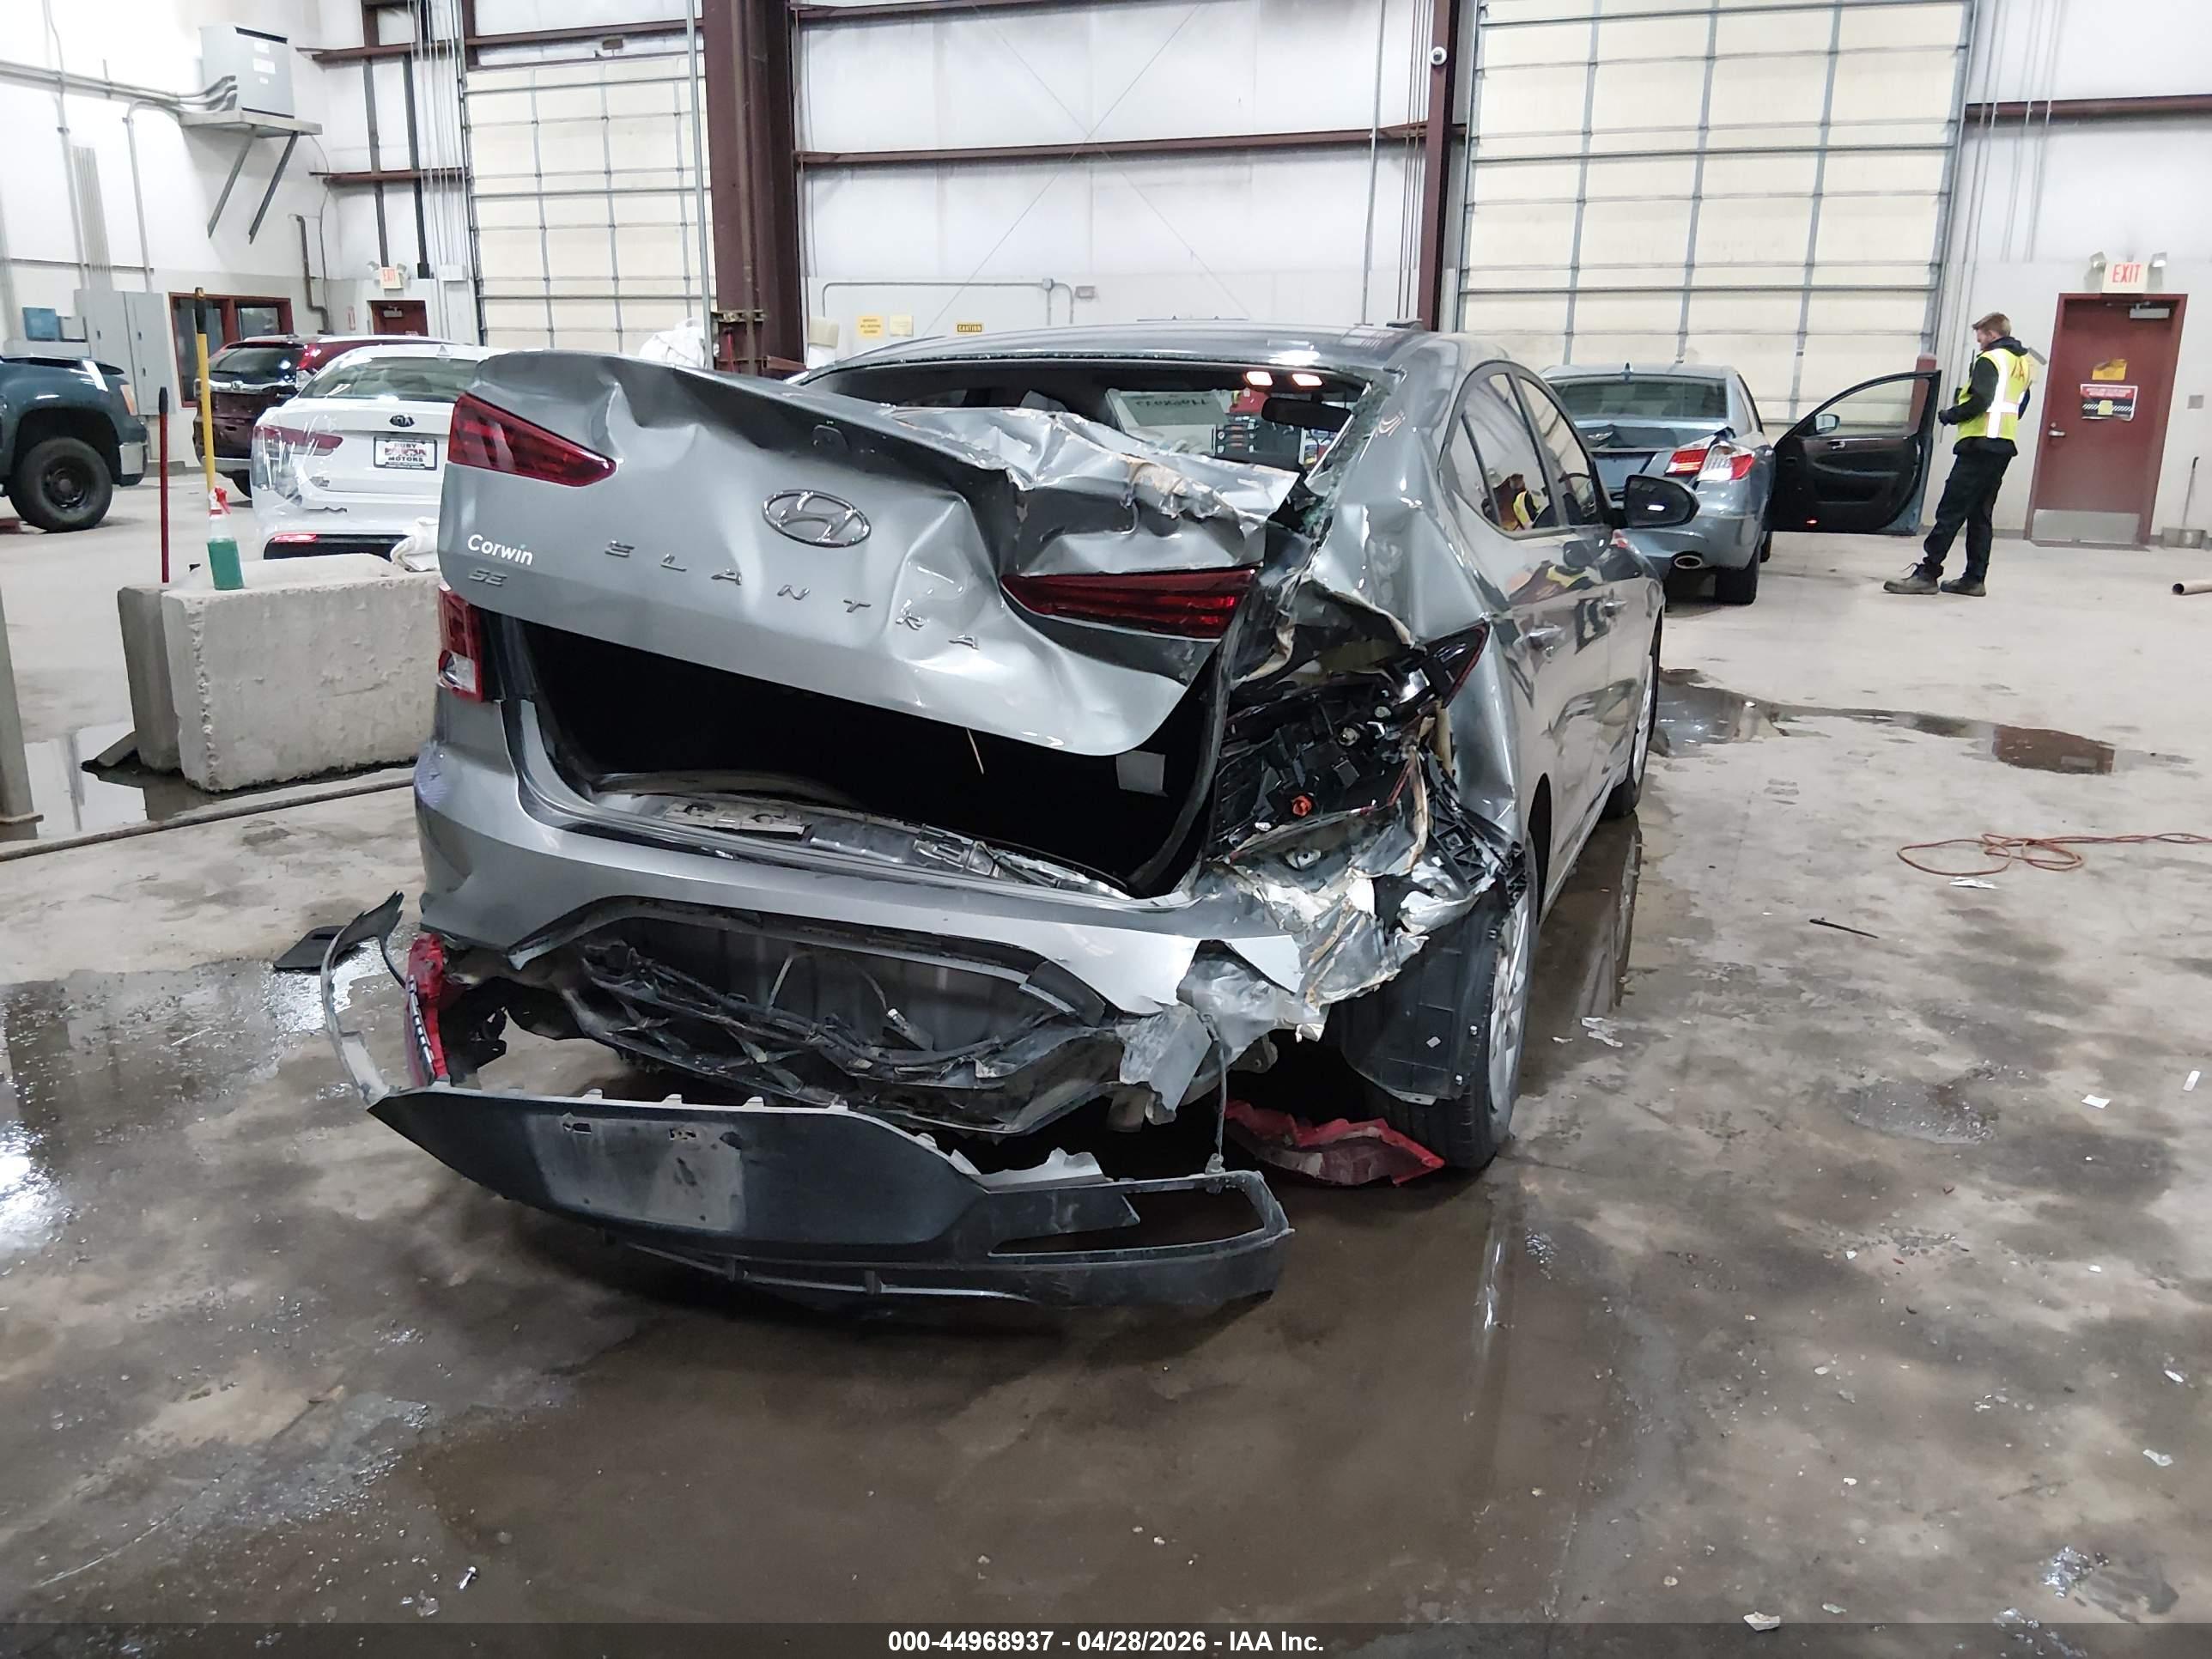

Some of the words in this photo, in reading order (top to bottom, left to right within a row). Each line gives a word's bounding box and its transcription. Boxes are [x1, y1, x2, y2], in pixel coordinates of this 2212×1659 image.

[2112, 264, 2141, 283] EXIT
[467, 534, 533, 565] Corwin
[467, 568, 508, 587] SE
[605, 540, 979, 650] ELANTRA
